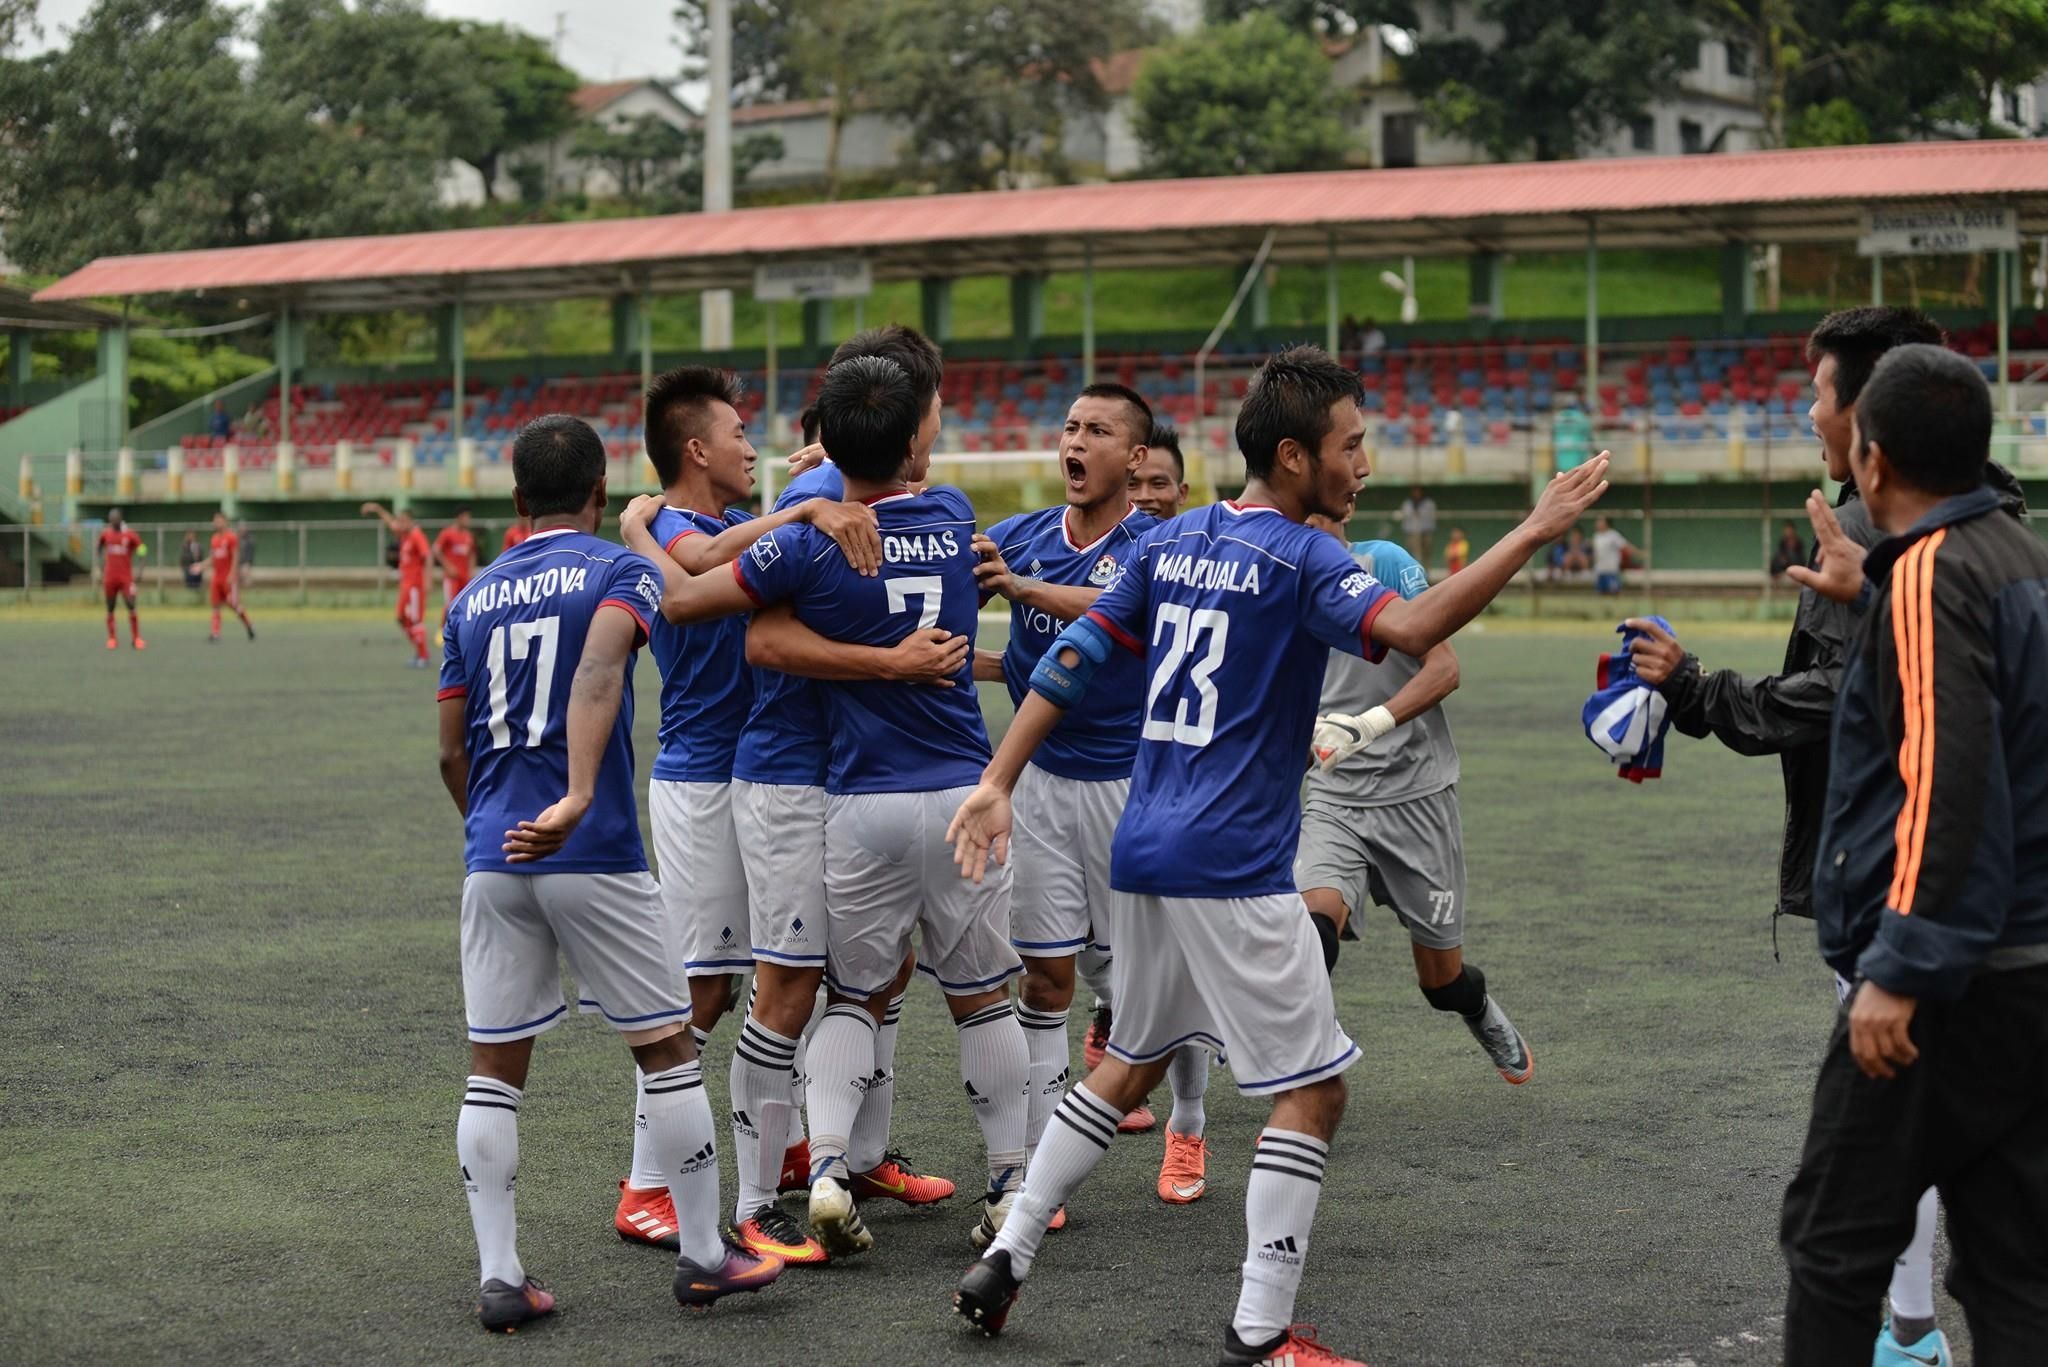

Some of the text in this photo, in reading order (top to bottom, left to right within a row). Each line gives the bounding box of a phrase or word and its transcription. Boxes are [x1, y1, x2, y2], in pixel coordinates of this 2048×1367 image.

[884, 530, 959, 563] OMAS
[466, 567, 587, 621] MUANZOVA
[487, 615, 560, 749] 17
[1142, 602, 1229, 747] 23
[1428, 890, 1455, 925] 72
[1257, 1249, 1300, 1265] adidas
